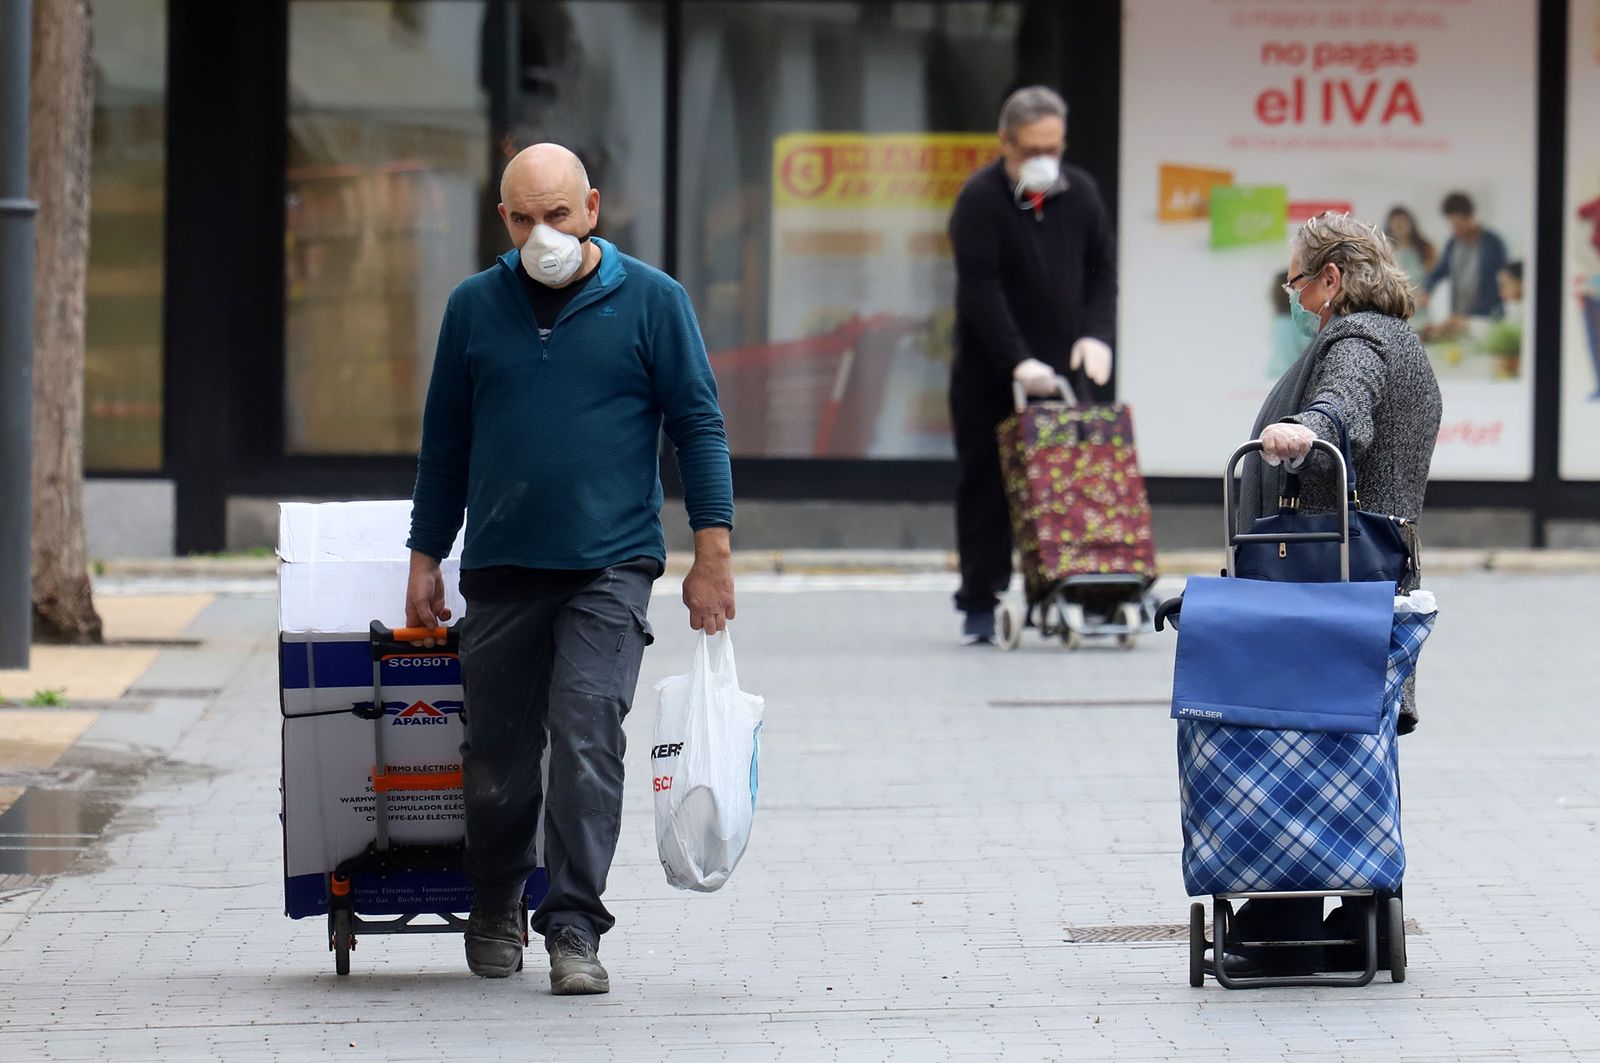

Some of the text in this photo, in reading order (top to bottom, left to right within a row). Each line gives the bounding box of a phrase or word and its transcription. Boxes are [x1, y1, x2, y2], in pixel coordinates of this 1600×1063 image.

[1260, 41, 1418, 74] no pagas
[1255, 76, 1423, 126] el IVA
[388, 657, 452, 667] SC050T
[1189, 708, 1223, 719] ROLSER
[392, 716, 448, 726] APARICI
[413, 764, 460, 772] ELÉCTRICO
[353, 803, 464, 812] TERMCUMULADOR ELÉC
